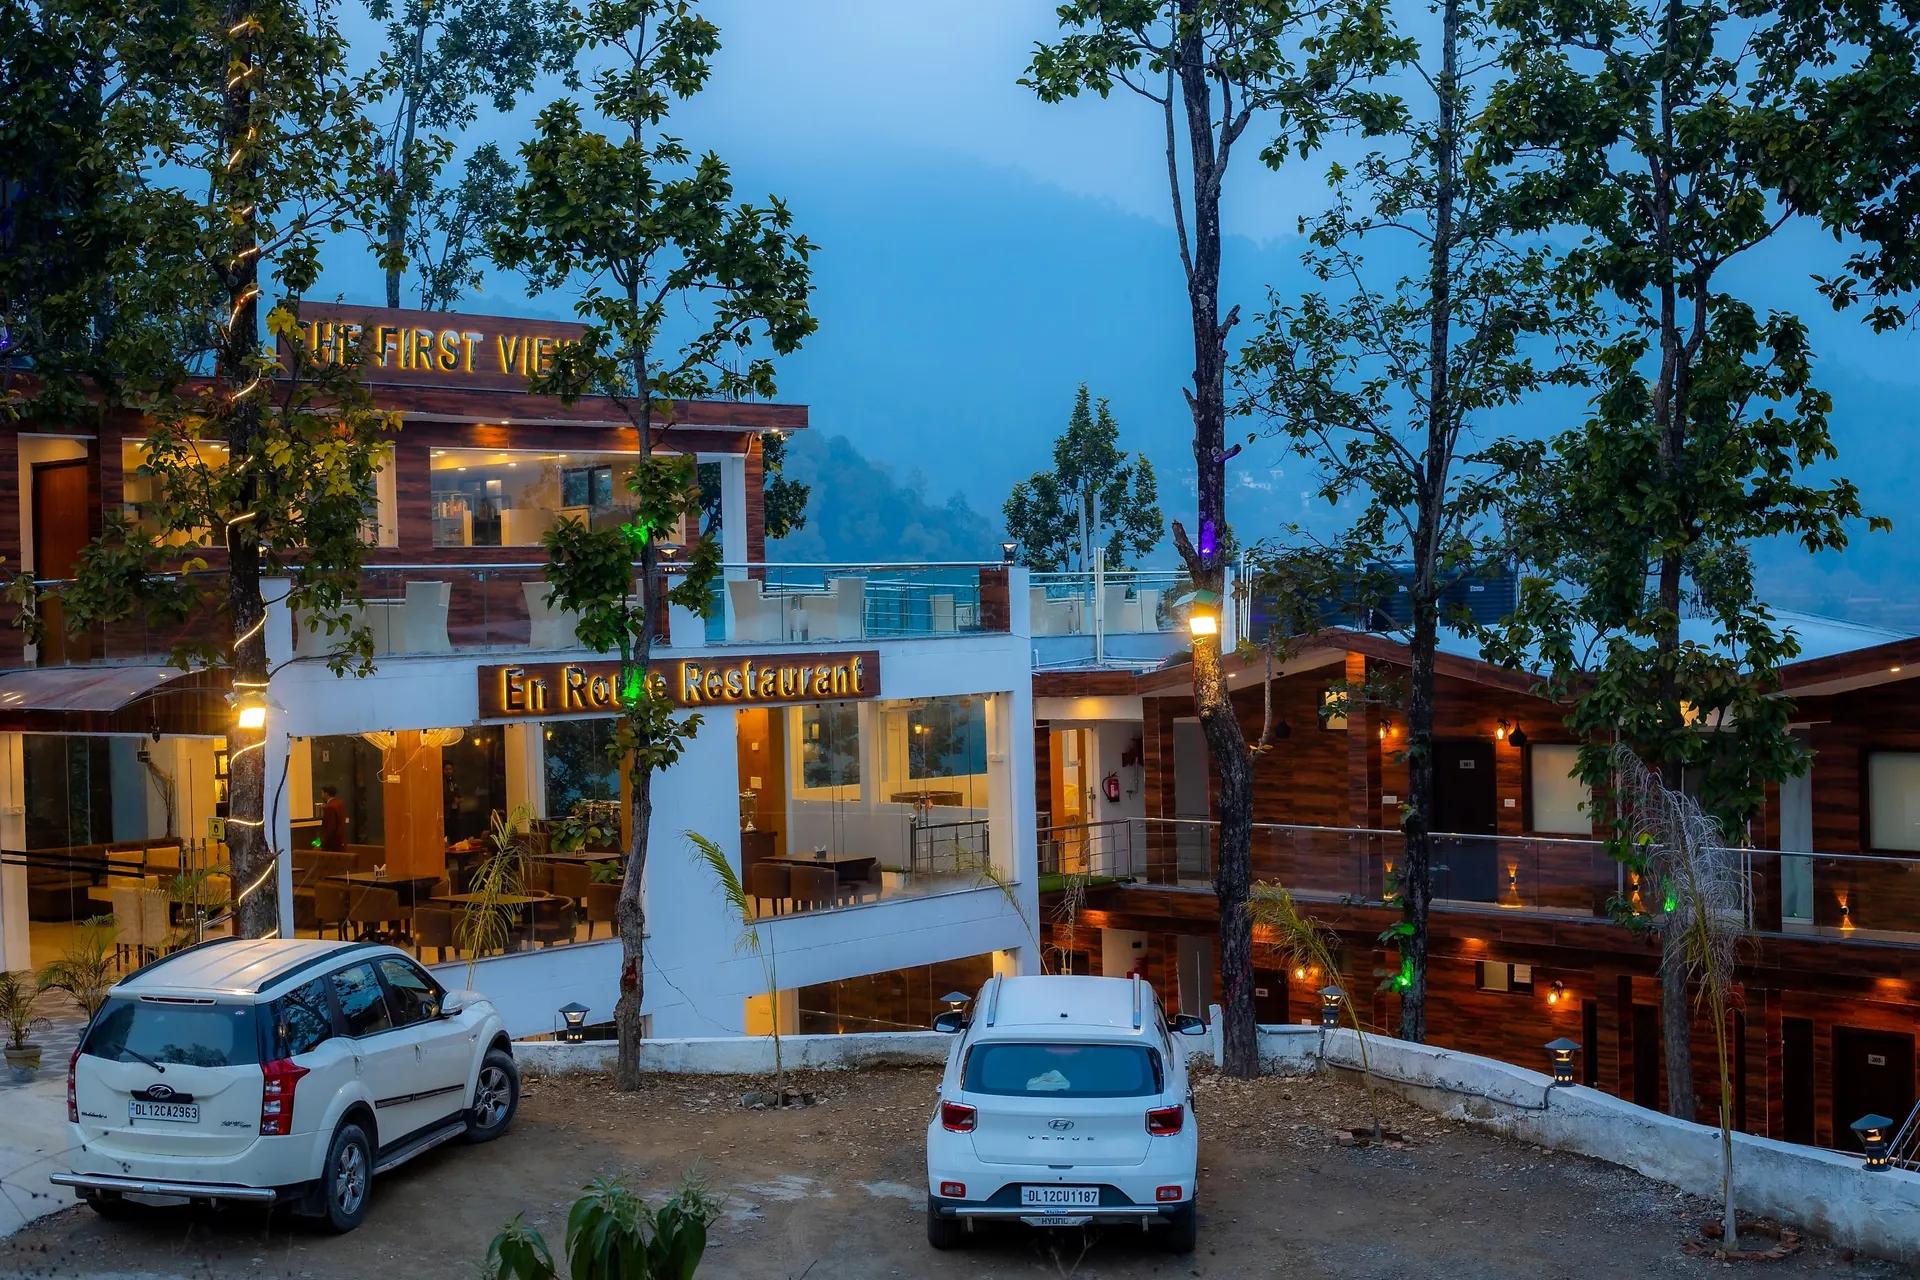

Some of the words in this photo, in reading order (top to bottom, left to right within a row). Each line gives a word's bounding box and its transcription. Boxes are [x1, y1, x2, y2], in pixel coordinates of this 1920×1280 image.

[378, 326, 484, 372] FIRST
[498, 334, 586, 378] VIE
[503, 668, 547, 711] En
[564, 666, 667, 709] Roe
[682, 656, 865, 702] Restaurant
[135, 1104, 198, 1119] DL12CA2963
[1028, 1190, 1098, 1203] DL12CU1187
[1041, 1217, 1077, 1225] HYUND
